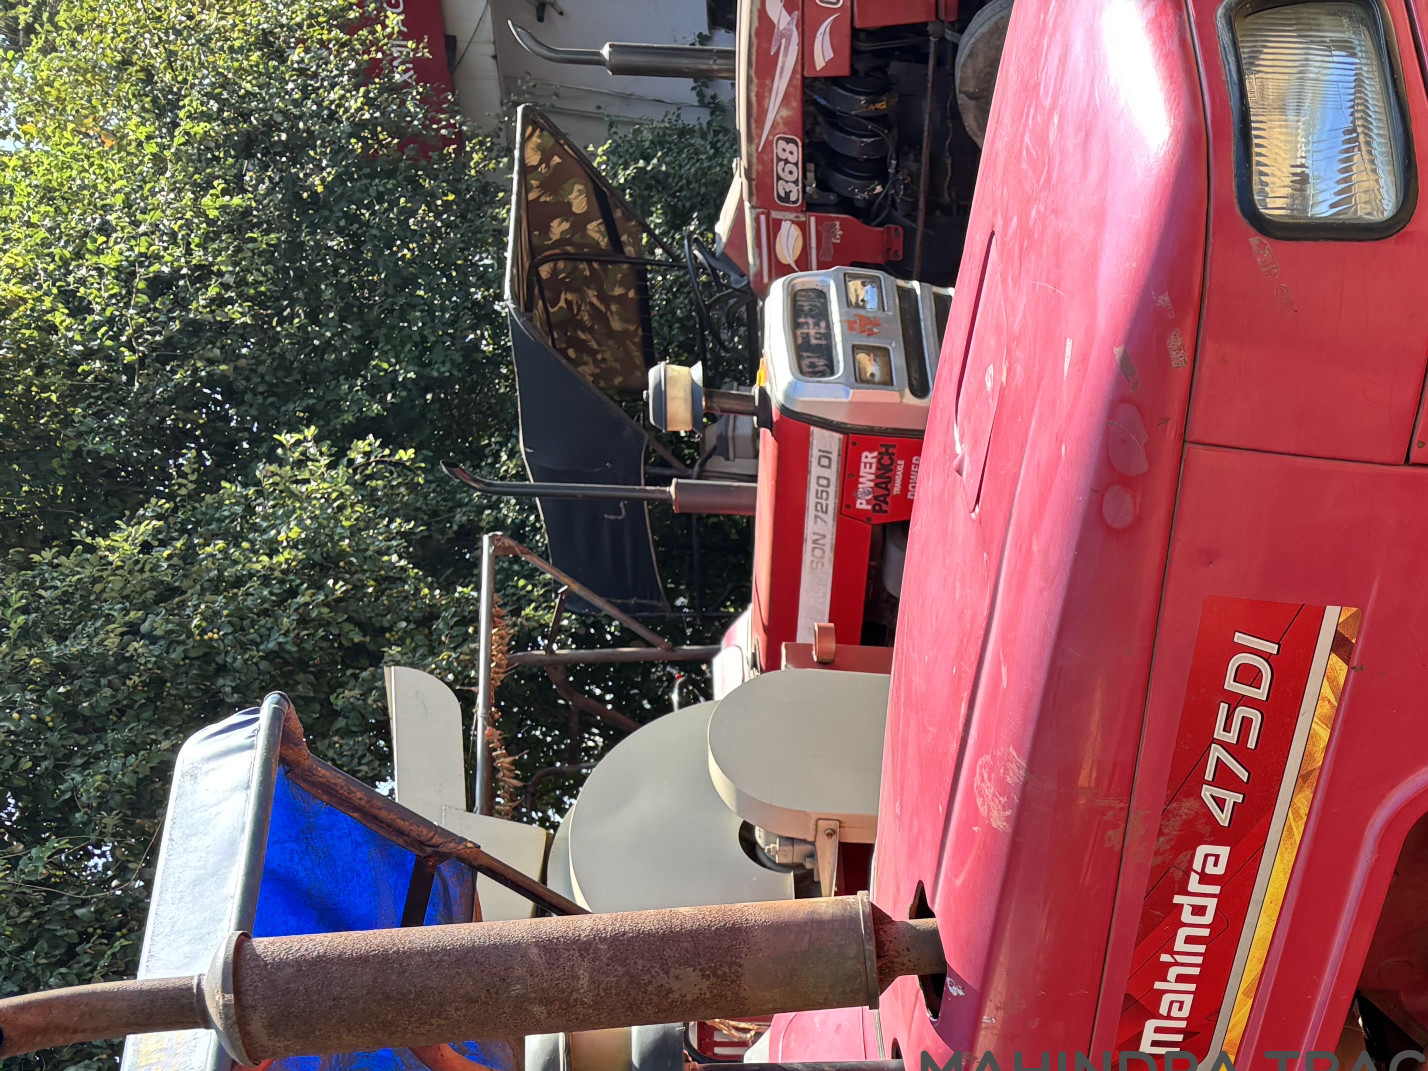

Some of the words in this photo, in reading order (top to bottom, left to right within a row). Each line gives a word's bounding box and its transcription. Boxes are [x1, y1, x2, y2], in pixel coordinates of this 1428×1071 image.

[776, 138, 799, 202] 368
[813, 475, 832, 525] 7250
[855, 451, 878, 510] POWER
[871, 443, 897, 515] PAANCH
[893, 459, 905, 496] TRANSAXLE
